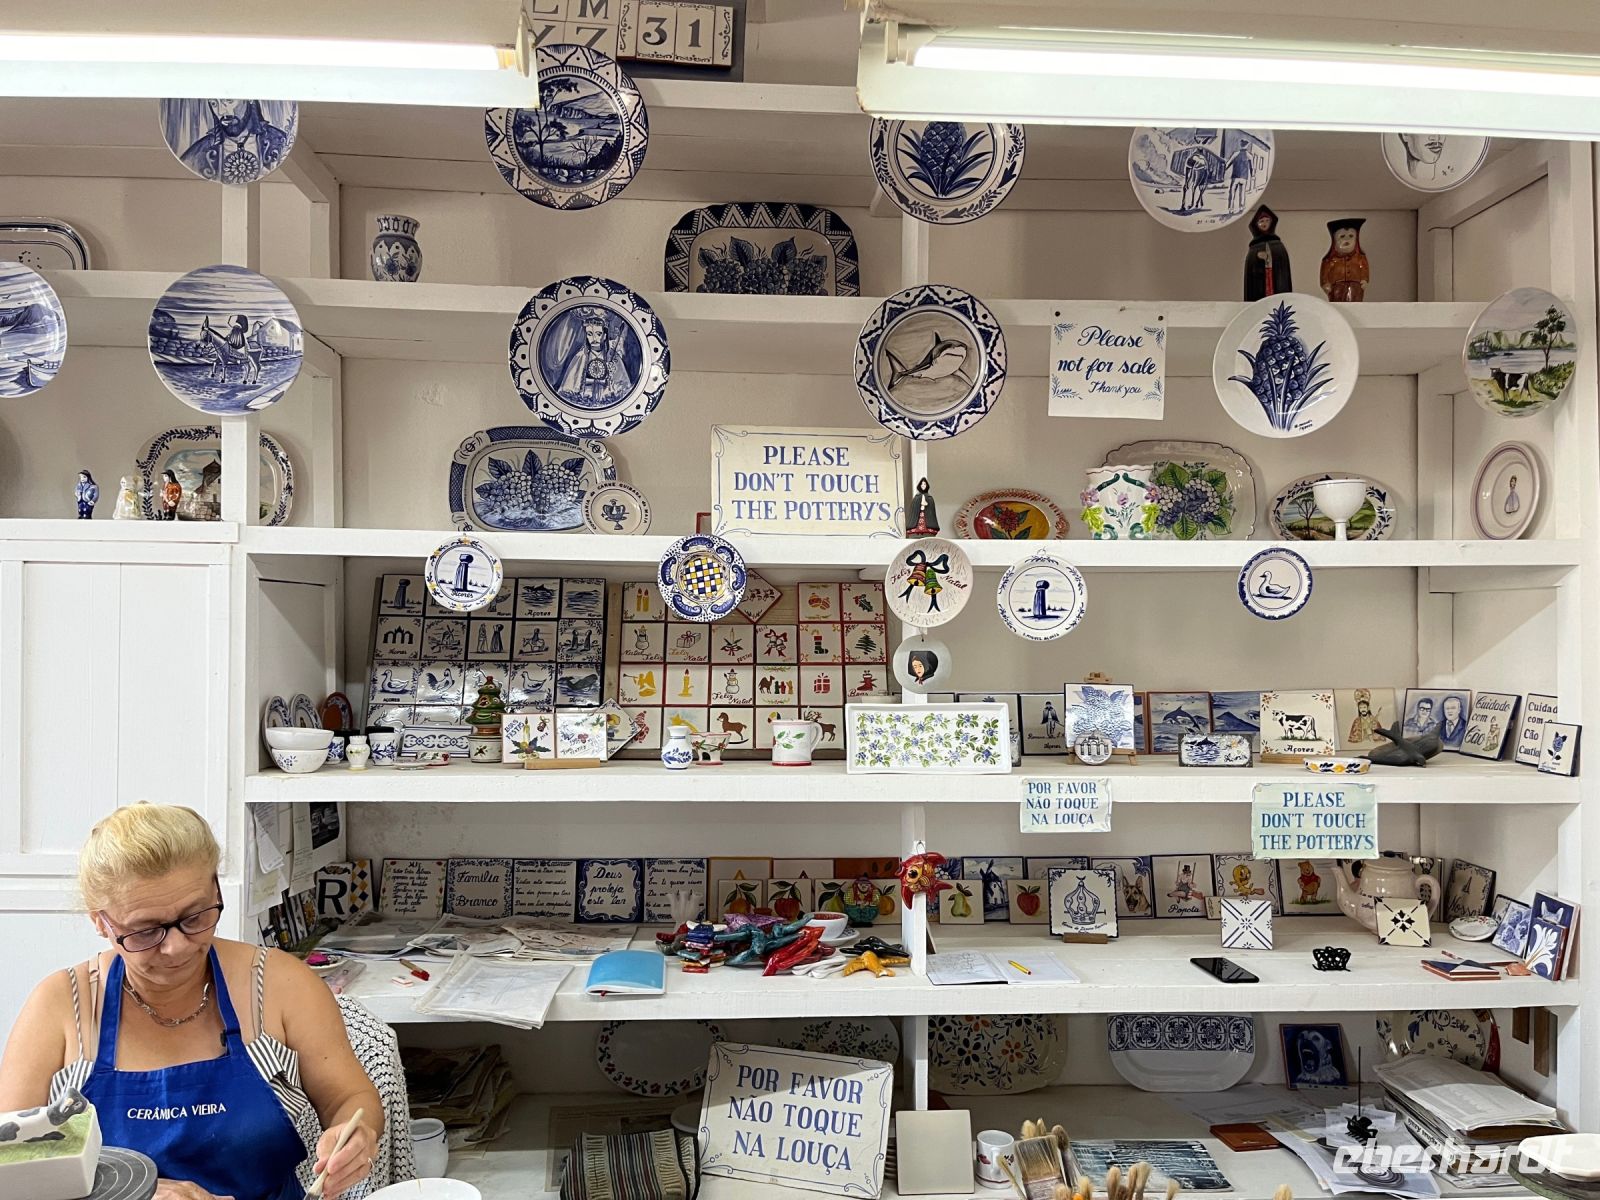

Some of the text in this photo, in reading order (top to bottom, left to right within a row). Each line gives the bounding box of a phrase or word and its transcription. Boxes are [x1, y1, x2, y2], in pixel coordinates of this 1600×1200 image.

[1077, 325, 1144, 348] Please
[1057, 357, 1157, 380] not for sale
[1088, 380, 1142, 398] Thank you
[763, 445, 850, 467] PLEASE
[734, 472, 879, 493] DON'T TOUCH
[731, 500, 891, 521] THE POTTERY'S
[890, 568, 911, 584] Feliz
[940, 575, 968, 590] Natal
[1475, 695, 1511, 712] Cuidado
[1528, 701, 1558, 714] Cuidad
[1471, 713, 1489, 722] com
[1527, 716, 1544, 724] com
[1464, 725, 1486, 746] Cão
[1524, 728, 1539, 741] Cão
[1283, 744, 1314, 754] Açores
[1028, 782, 1097, 794] POR FAVOR
[1026, 796, 1099, 810] NÃO TOQUE
[1283, 791, 1345, 808] PLEASE
[1031, 813, 1095, 828] NA LOUÇA
[1262, 813, 1367, 828] DON'T TOUCH
[1259, 834, 1374, 850] THE POTTERY'S
[593, 867, 623, 879] Deus
[317, 878, 348, 915] R
[455, 895, 498, 907] Branco
[736, 1064, 864, 1105] POR FAVOR
[127, 1102, 227, 1121] CERÂMICA VIEIRA
[727, 1094, 863, 1138] NÃO TOQUE
[732, 1129, 852, 1175] NA LOUÇA
